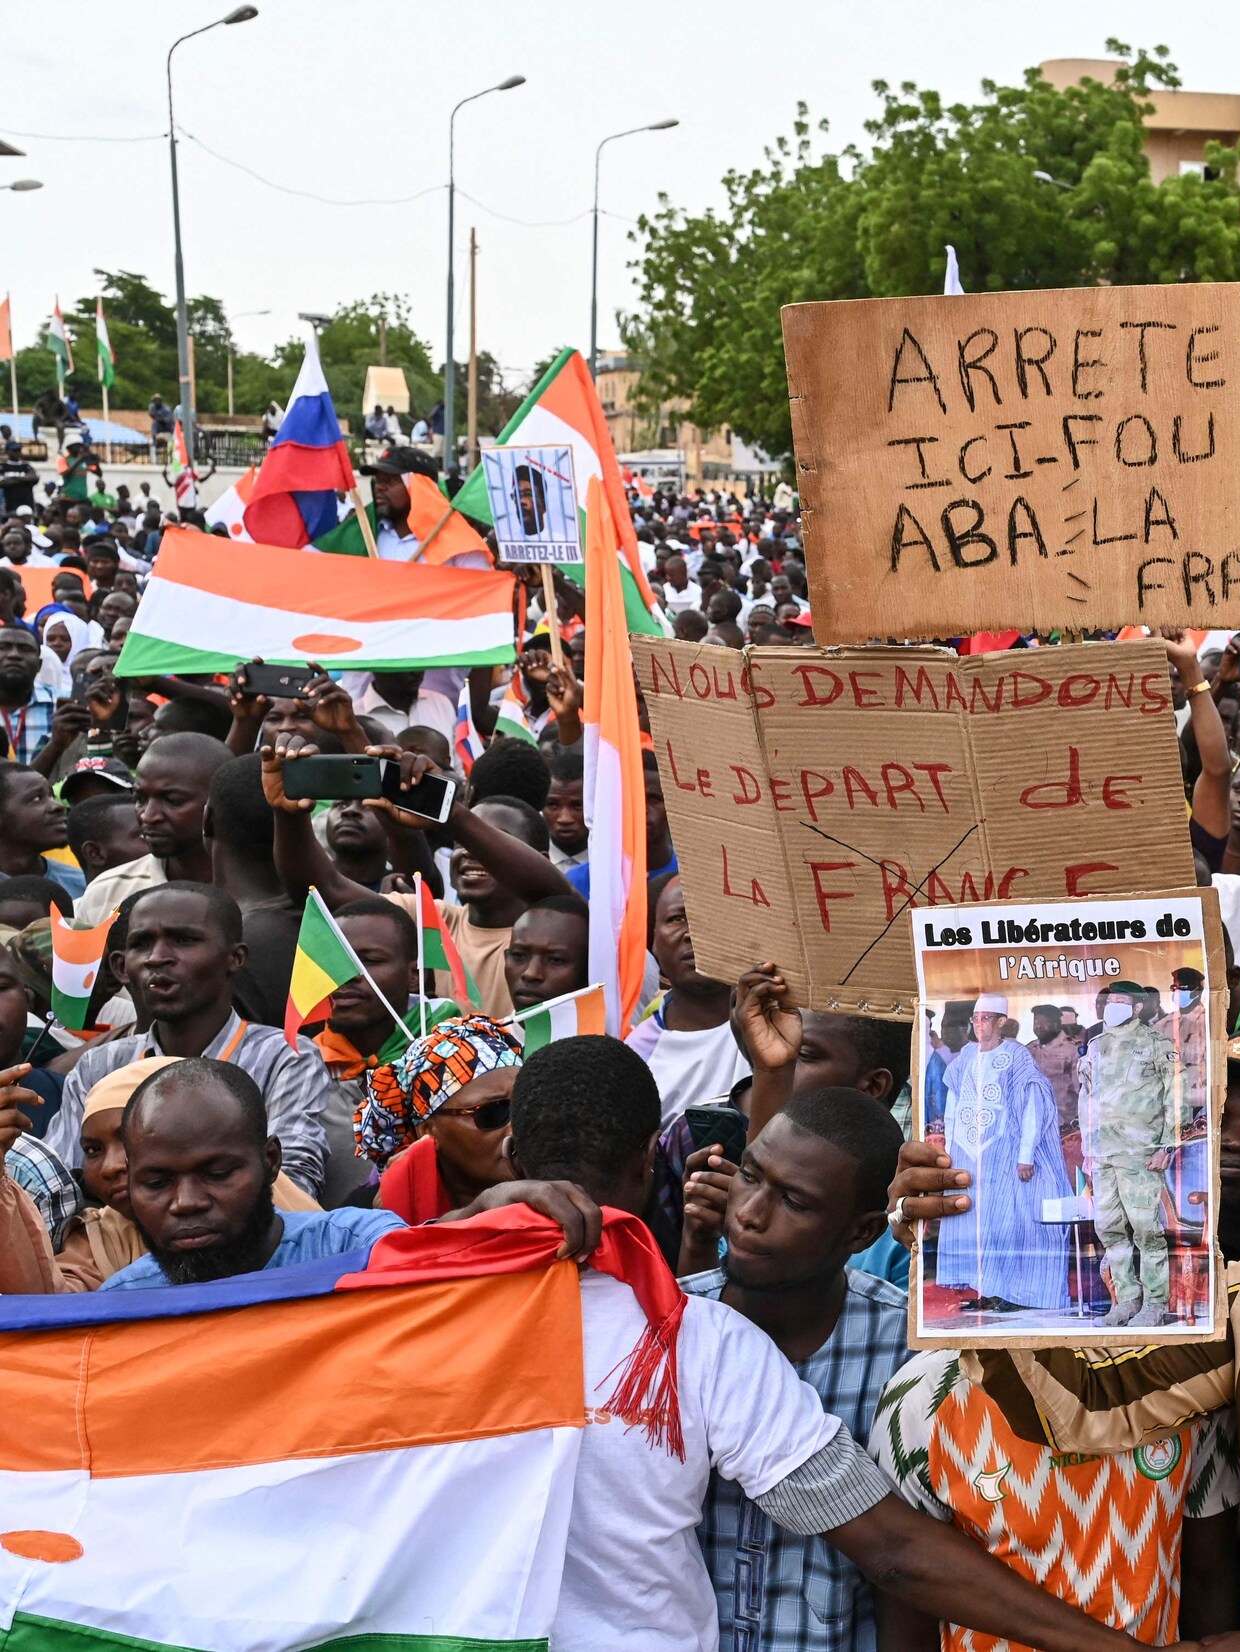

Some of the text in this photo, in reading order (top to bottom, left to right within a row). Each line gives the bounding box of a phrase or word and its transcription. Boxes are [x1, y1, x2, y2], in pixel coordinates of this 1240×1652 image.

[887, 412, 1215, 489] ICI-FOU
[504, 544, 564, 561] ARRETEZ-LE
[890, 486, 1180, 573] ABA LA
[651, 652, 1172, 715] NOUS DEMANDONS
[924, 913, 1191, 947] Les Libérateurs de
[998, 953, 1122, 983] l'Afrique
